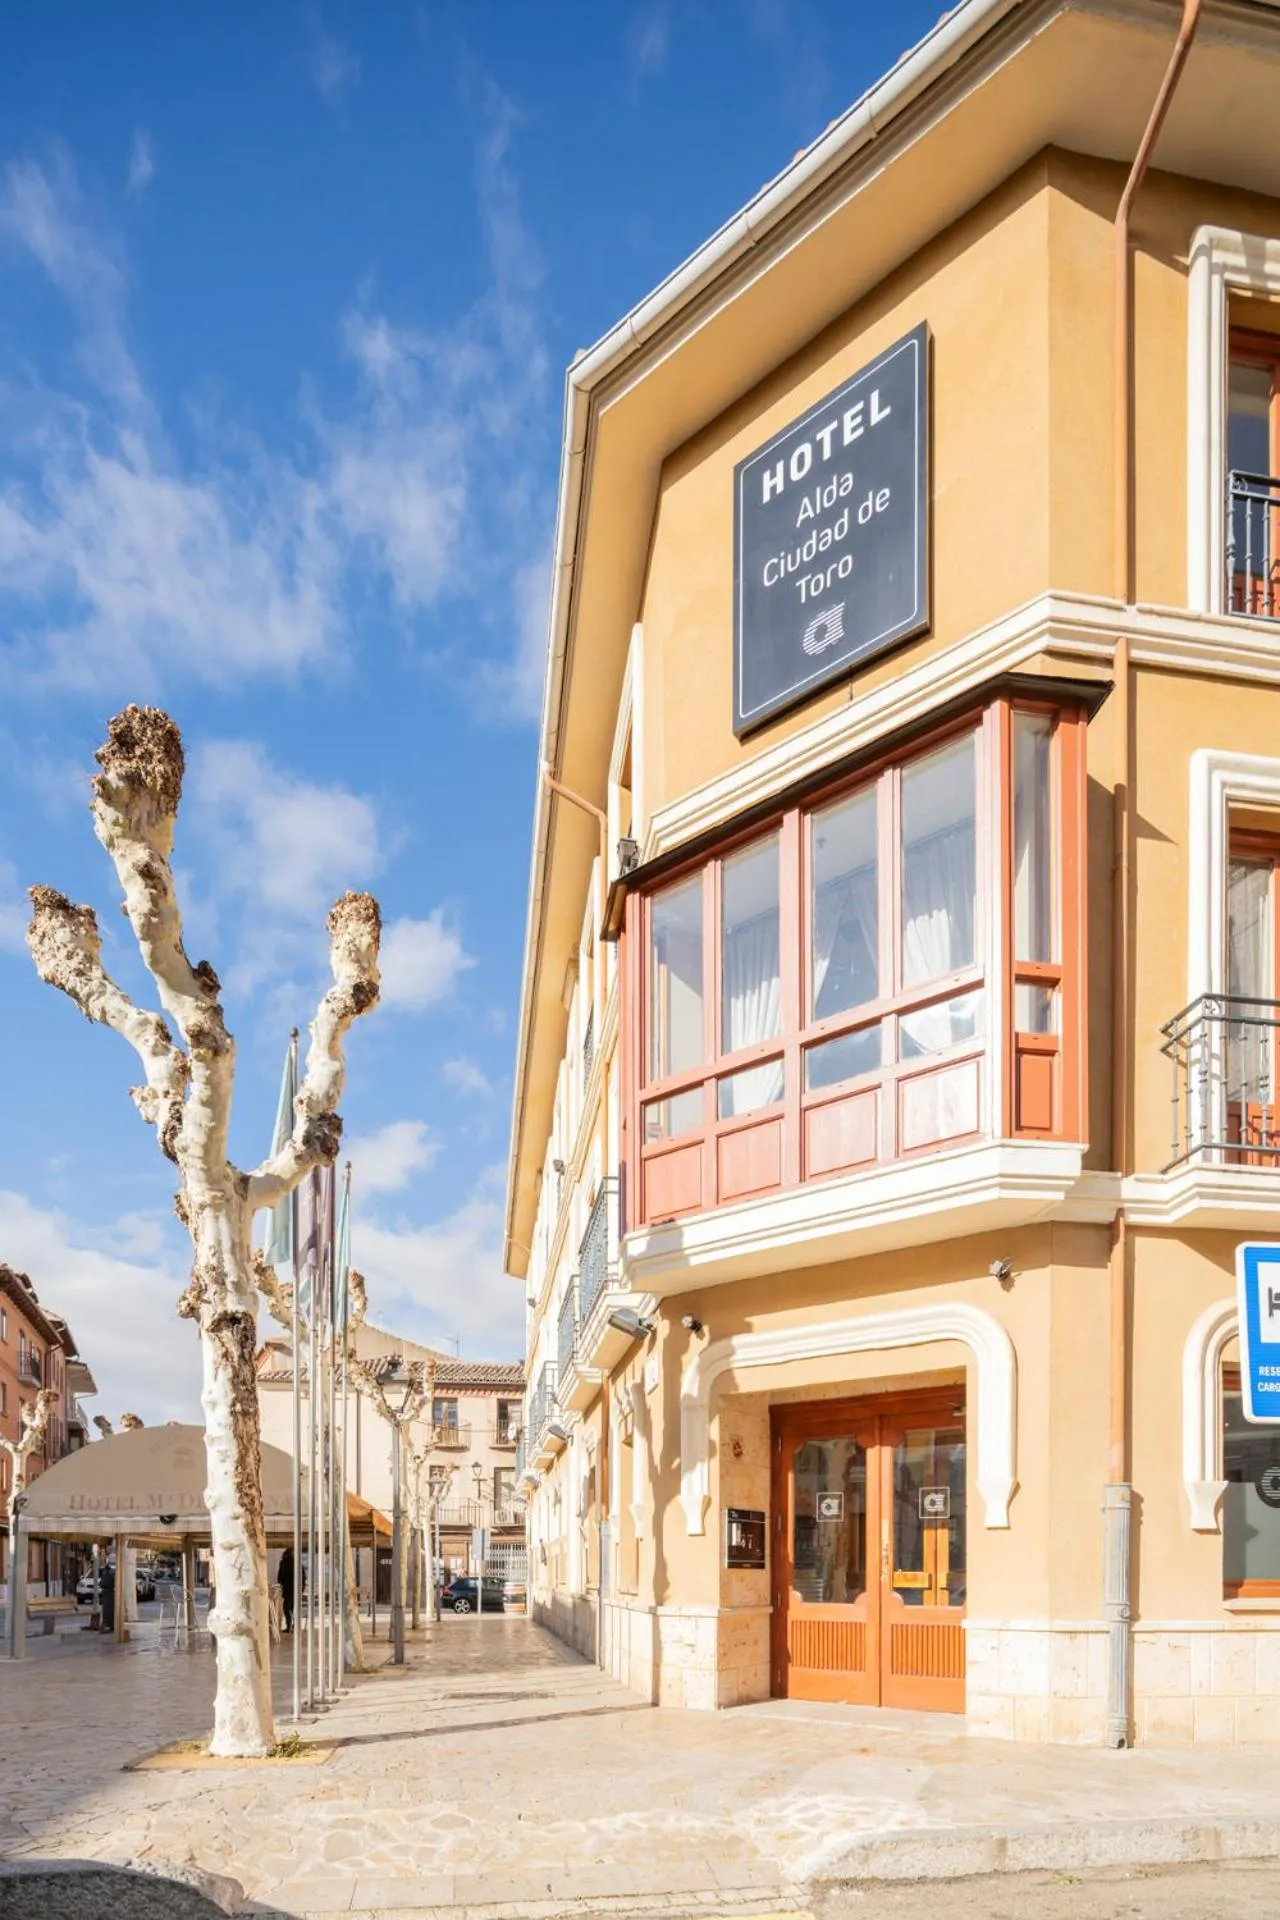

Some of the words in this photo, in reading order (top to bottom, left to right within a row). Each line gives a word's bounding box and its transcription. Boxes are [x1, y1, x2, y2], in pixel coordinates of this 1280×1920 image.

[761, 388, 891, 504] HOTEL
[795, 470, 854, 528] Alda
[762, 506, 849, 588] Ciudad
[858, 486, 891, 526] de
[795, 552, 854, 605] Toro
[69, 1494, 140, 1511] HOTEL
